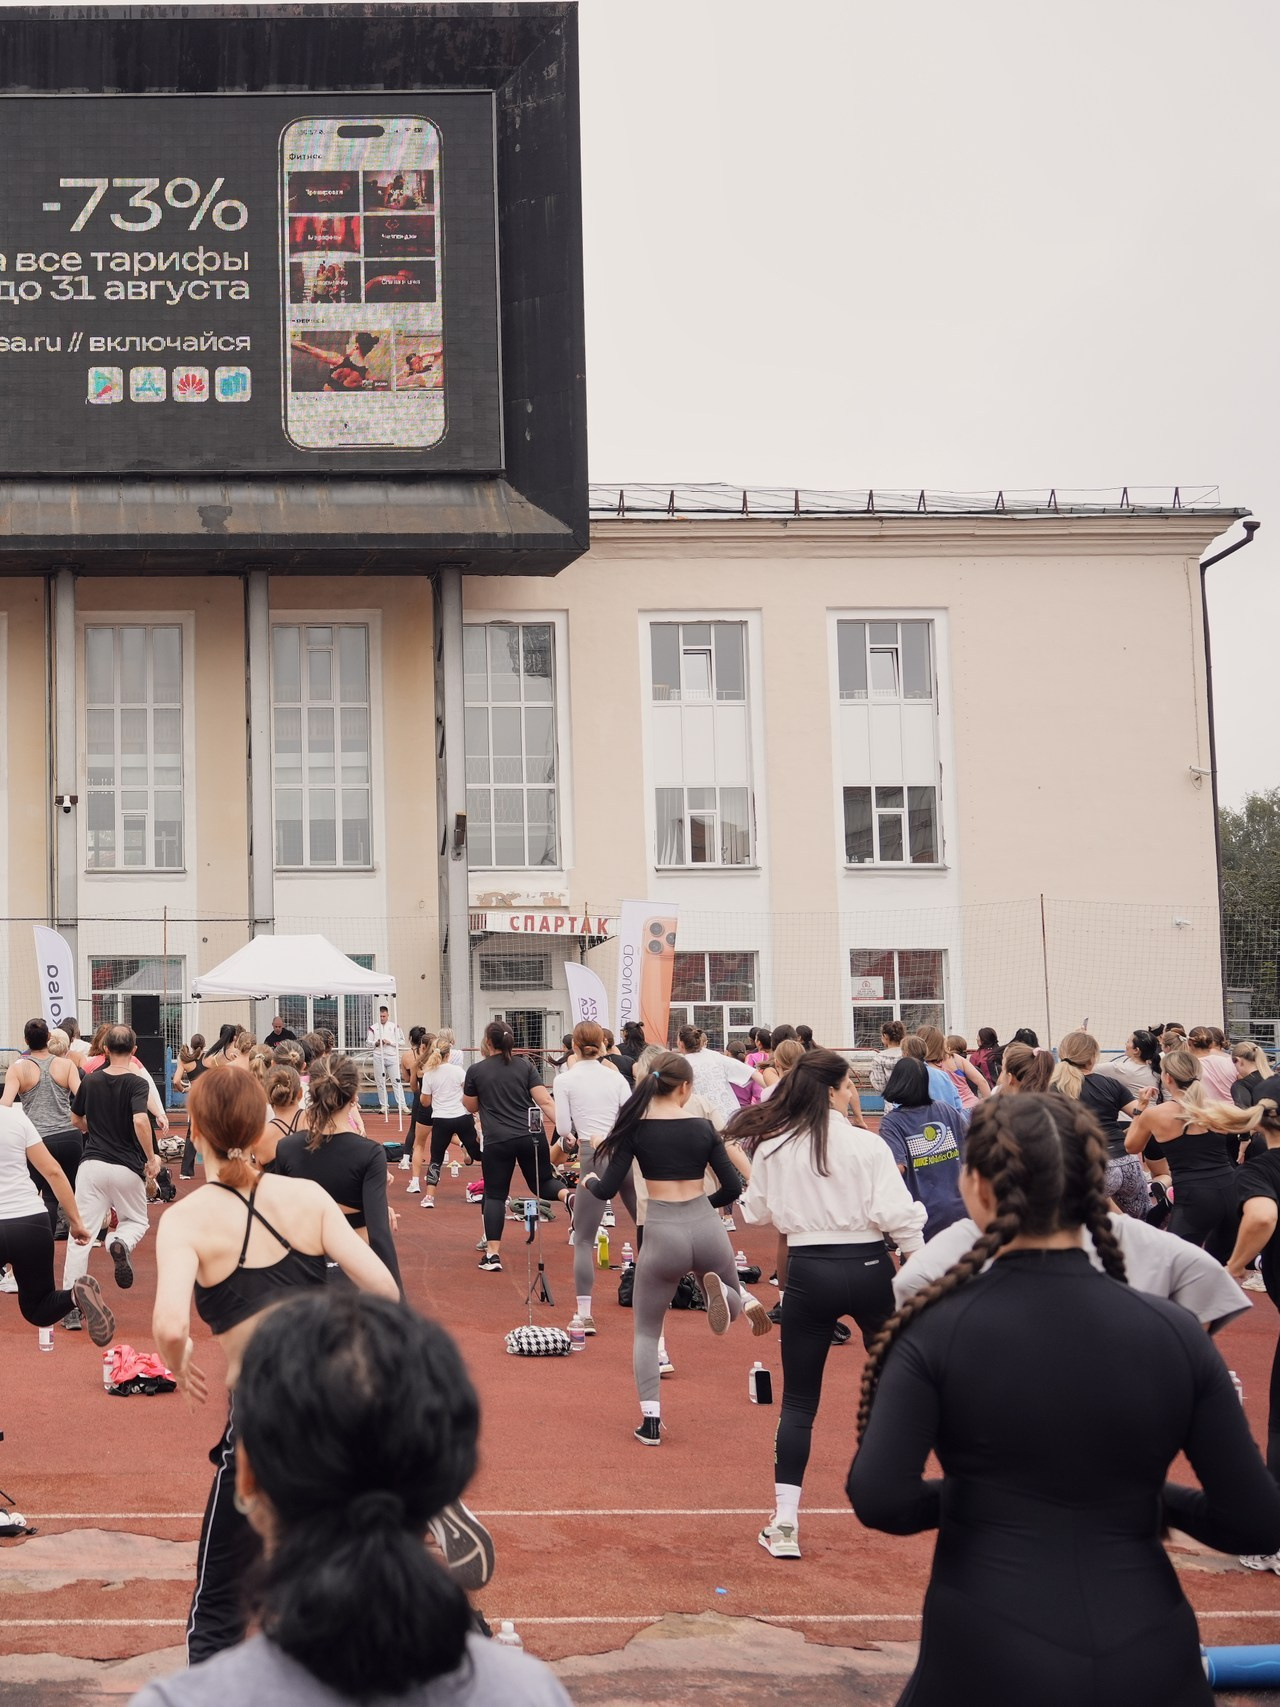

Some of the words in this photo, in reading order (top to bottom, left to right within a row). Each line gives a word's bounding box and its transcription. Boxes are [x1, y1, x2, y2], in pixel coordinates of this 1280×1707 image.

[42, 177, 249, 232] -73%
[15, 251, 82, 272] все
[90, 245, 249, 276] тарифы
[50, 275, 97, 301] 31
[103, 279, 250, 305] августа
[89, 331, 251, 352] включайся
[510, 915, 608, 935] СПАРТАК
